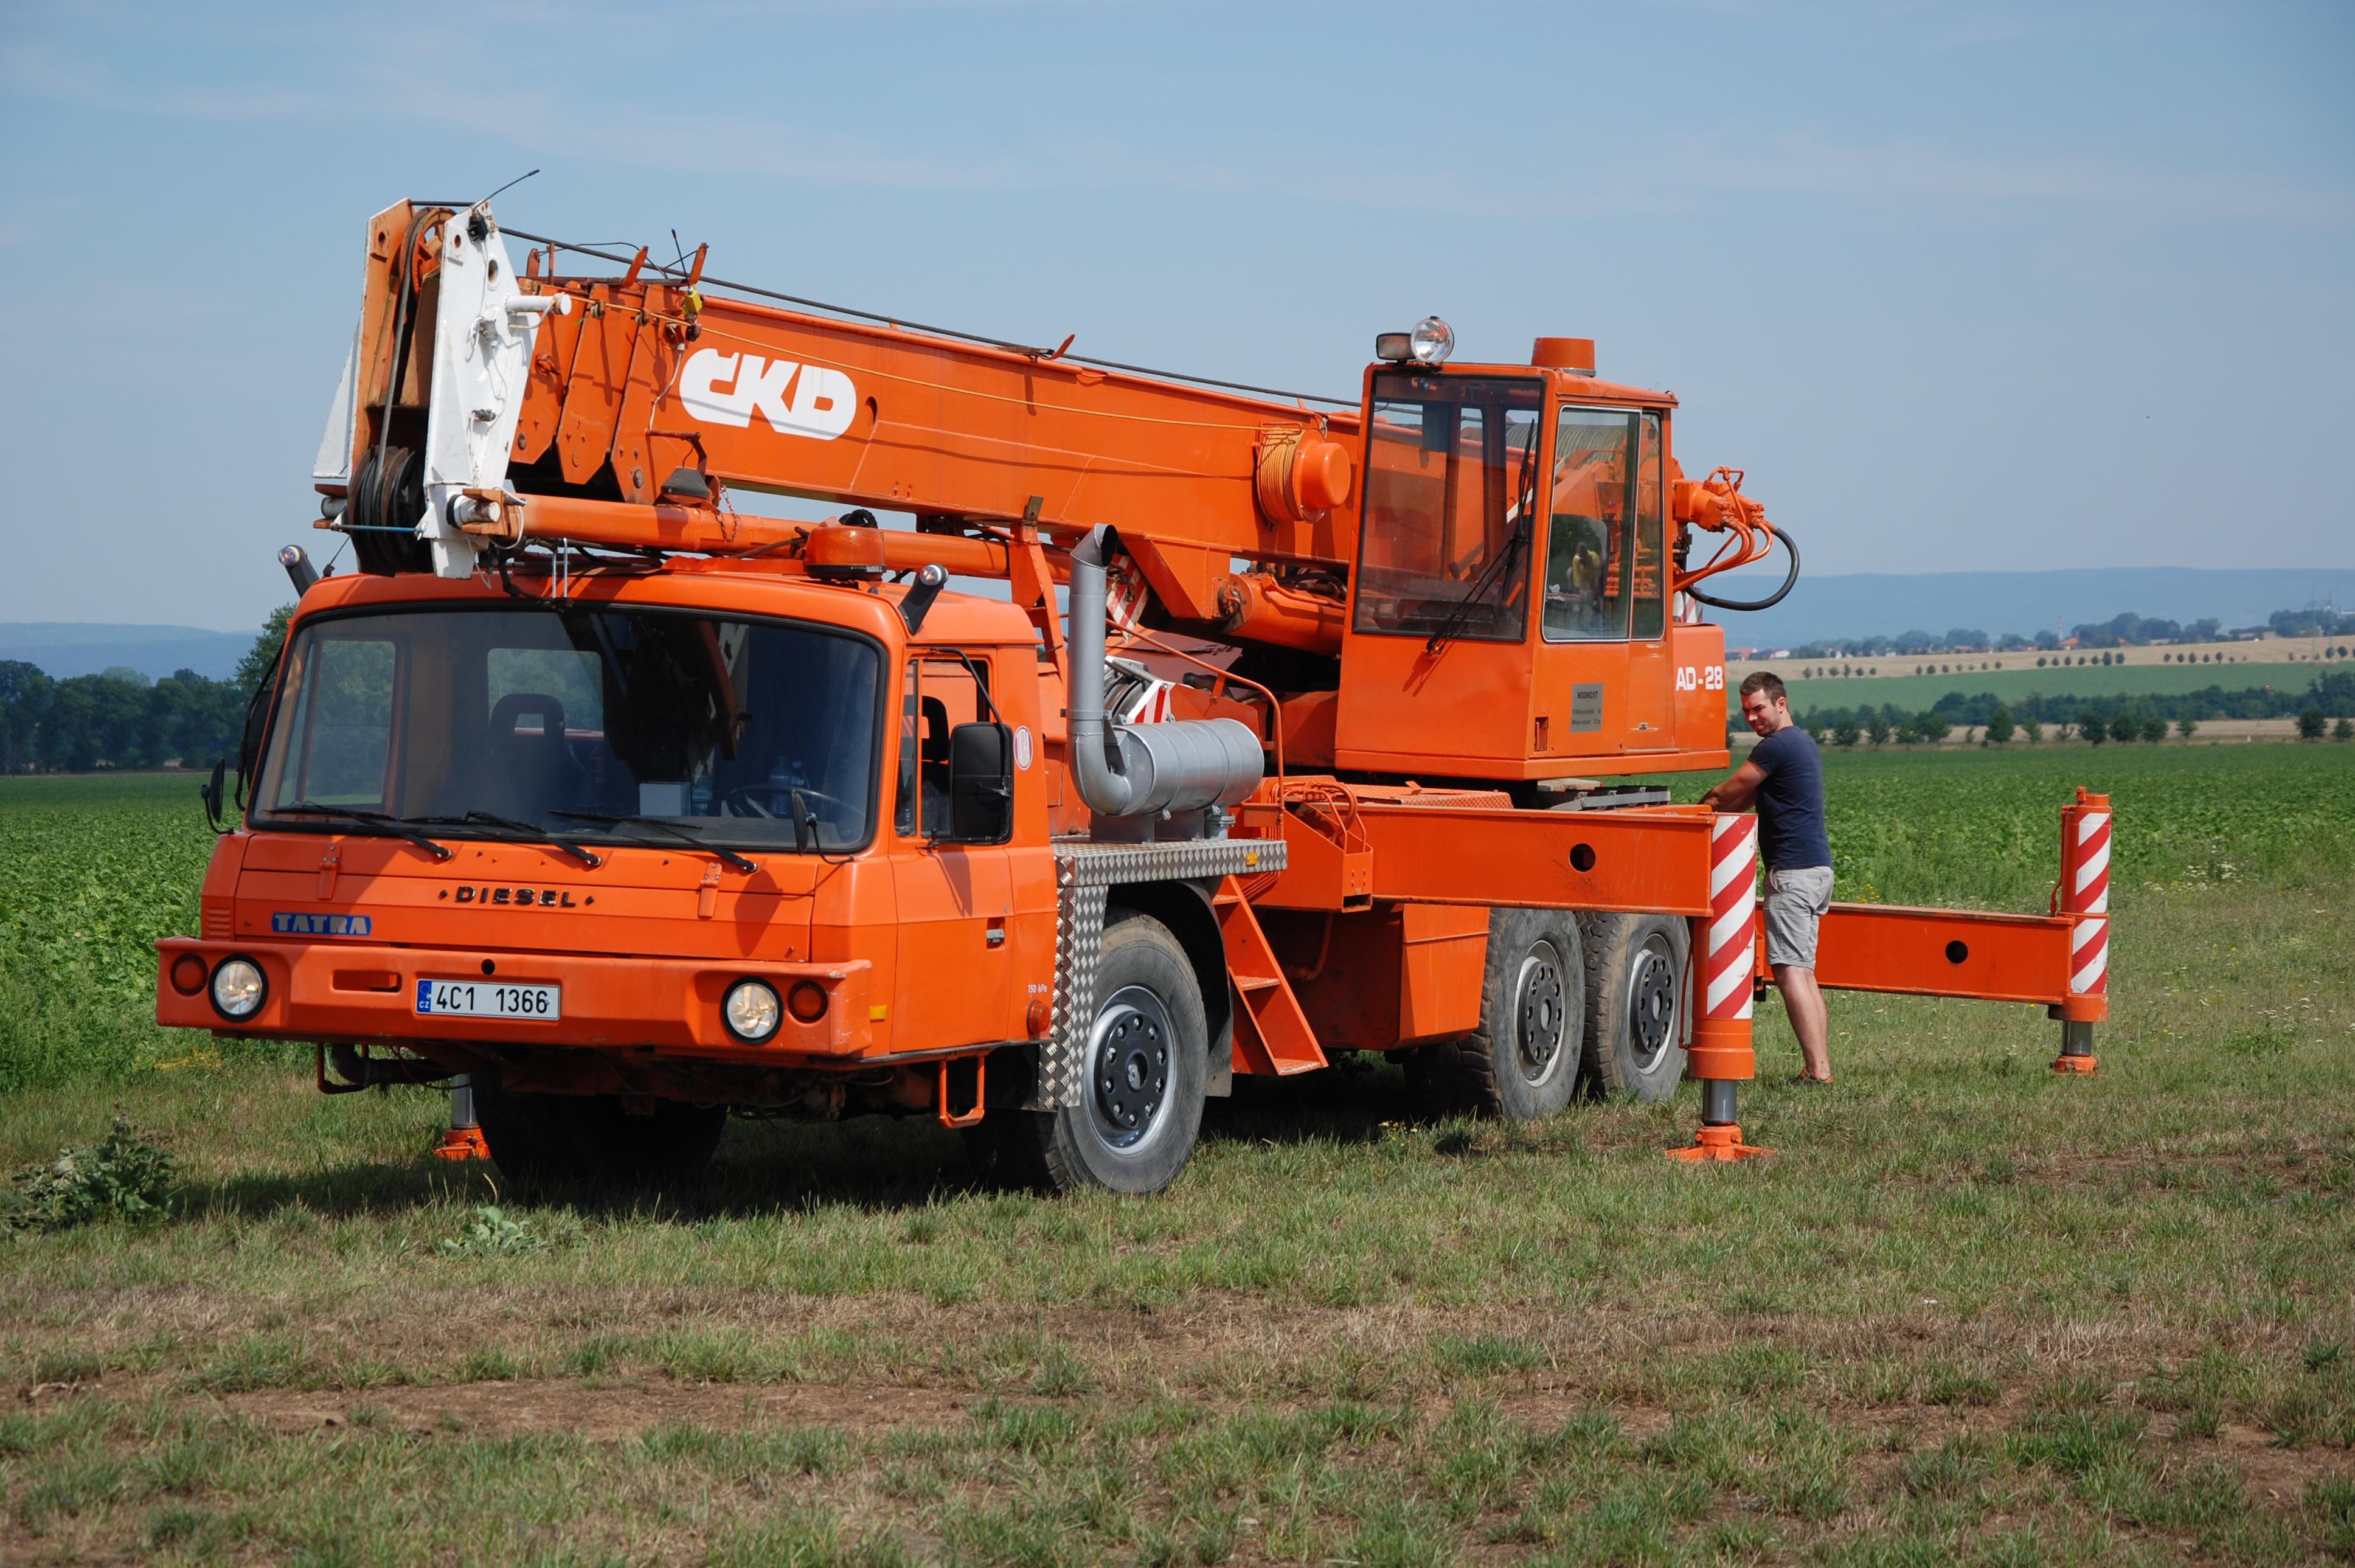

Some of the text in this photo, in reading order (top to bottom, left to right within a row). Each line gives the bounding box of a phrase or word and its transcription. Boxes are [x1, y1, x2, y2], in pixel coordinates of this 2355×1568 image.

[455, 886, 577, 907] DIESEL
[275, 914, 367, 934] TATRA
[436, 985, 548, 1014] 4C1 1366
